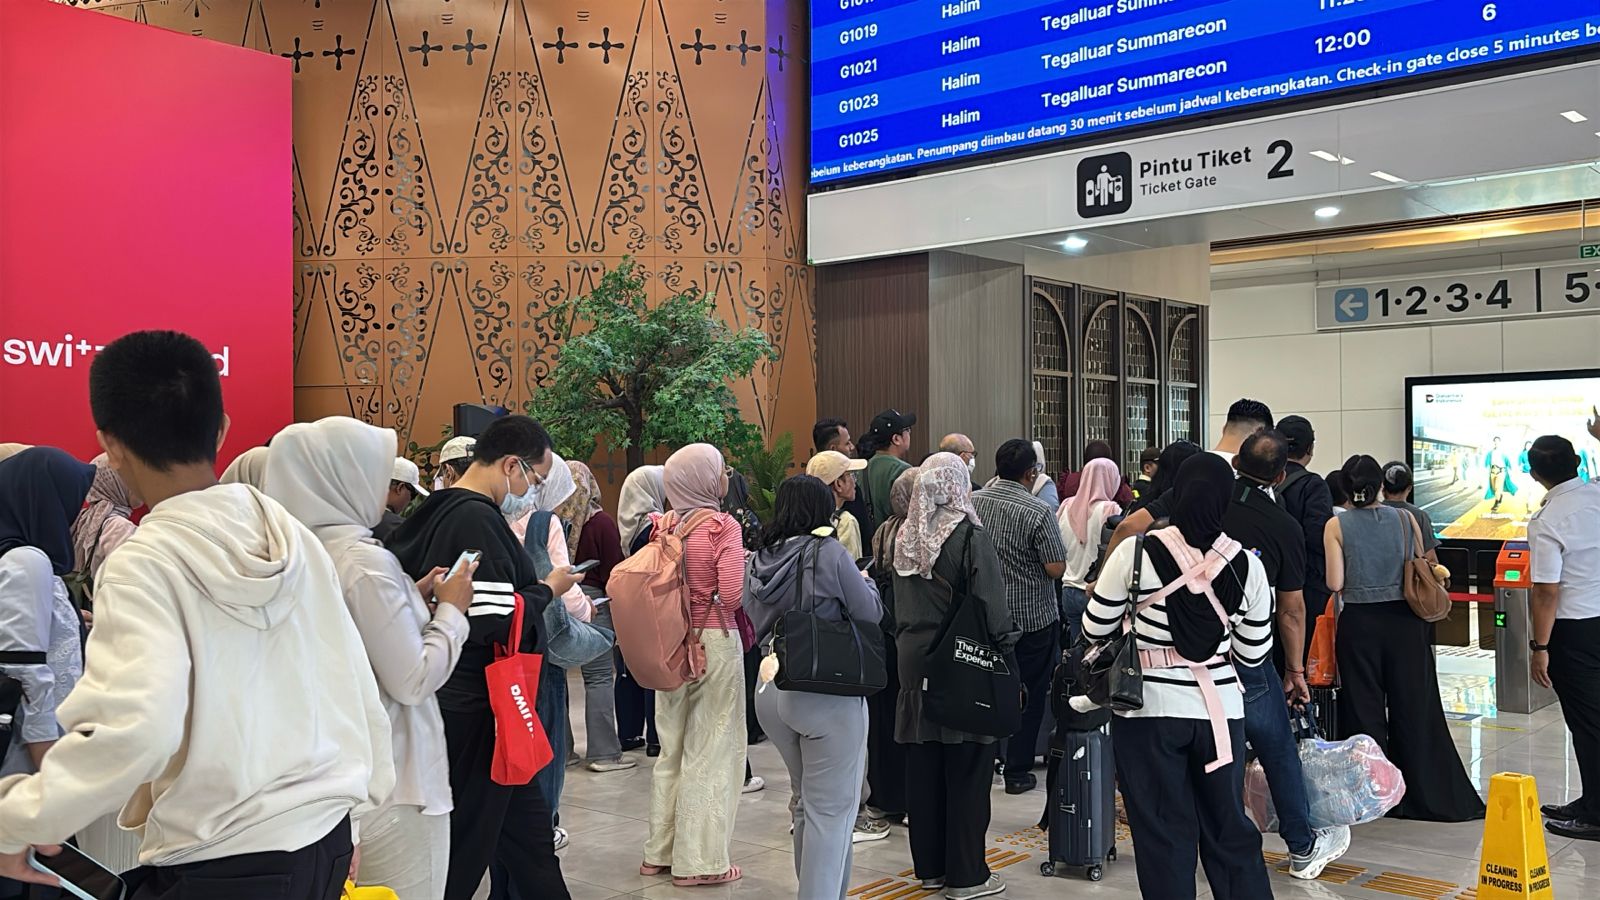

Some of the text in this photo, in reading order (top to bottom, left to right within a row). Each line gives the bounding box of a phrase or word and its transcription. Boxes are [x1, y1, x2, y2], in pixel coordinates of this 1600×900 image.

[840, 0, 980, 44] G1019 Halim
[840, 58, 877, 79] G1021
[941, 34, 980, 55] Halim
[1041, 4, 1113, 31] Tegalluar
[839, 17, 1227, 114] G1023 Halim Tegalluar Summarecon
[839, 3, 1497, 148] G1025 Halim Tegalluar Summarecon 12:00 6
[843, 152, 915, 172] keberangkatan.
[917, 140, 979, 158] Penumpang
[981, 131, 1025, 147] diimbau
[1027, 123, 1067, 138] datang
[1070, 118, 1084, 130] 30
[1087, 111, 1122, 127] menit
[1124, 102, 1176, 120] sebelum
[1179, 91, 1221, 113] jadwal
[1225, 74, 1333, 102] keberangkatan.
[1336, 60, 1402, 82] Check-in
[1406, 53, 1443, 73] gate
[1446, 45, 1489, 62] close
[1493, 40, 1503, 54] 5
[1508, 28, 1579, 51] minutes
[1140, 139, 1294, 180] Pintu Tiket 2
[1140, 175, 1217, 196] Ticket Gate
[955, 649, 994, 669] Experien
[956, 640, 973, 653] The
[1481, 875, 1522, 892] IN PROGRESS
[1486, 863, 1517, 878] CLEANING
[1530, 865, 1546, 879] CLEANING
